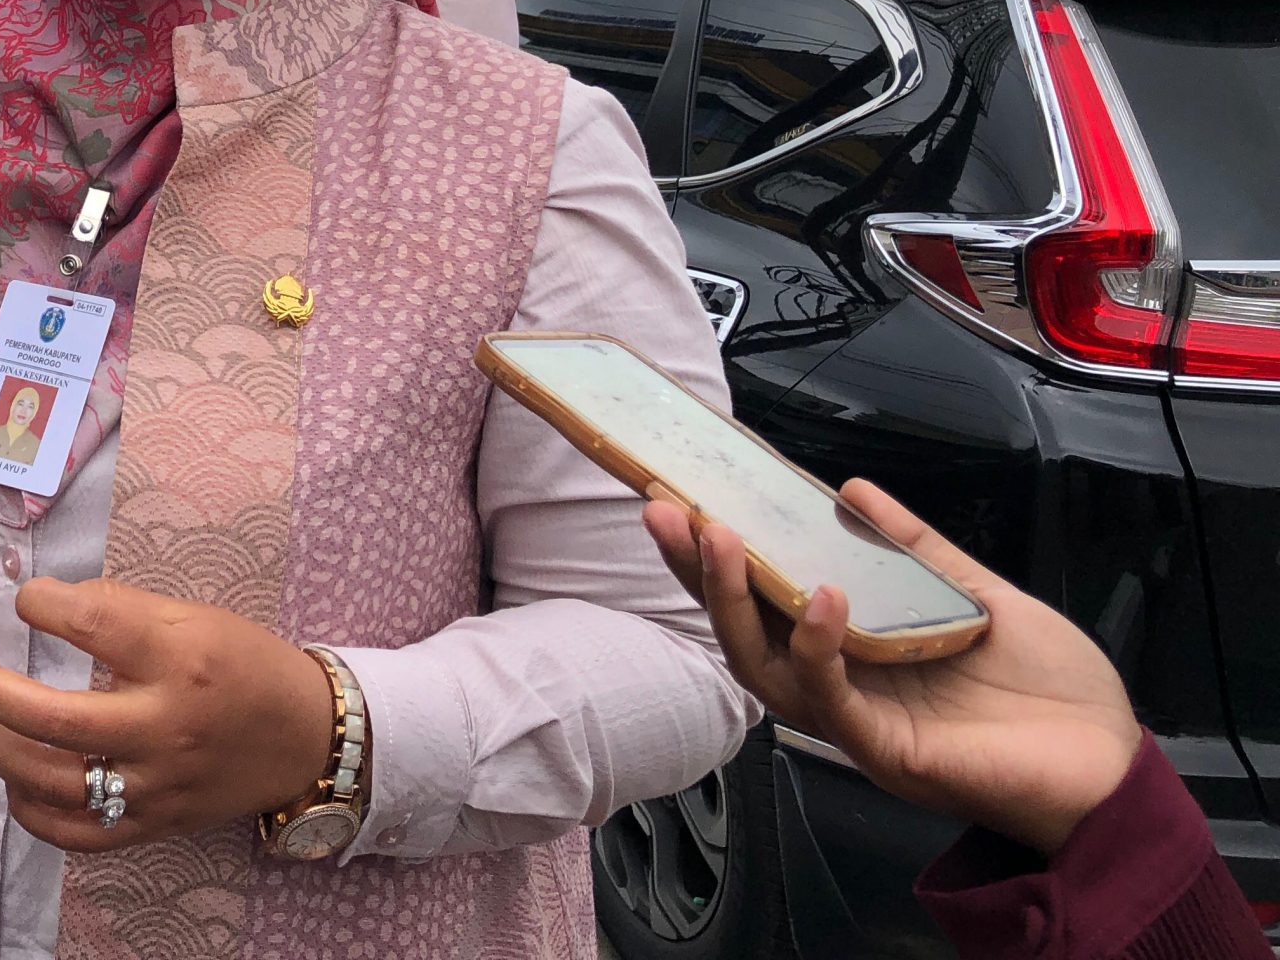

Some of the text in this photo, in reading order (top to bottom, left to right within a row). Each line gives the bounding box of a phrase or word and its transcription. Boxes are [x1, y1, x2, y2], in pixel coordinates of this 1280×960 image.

[4, 338, 82, 364] PEMERINTAH KABUPATEN
[17, 351, 62, 369] PONOROGO
[0, 364, 70, 388] DINAS KESEHATAN
[2, 463, 21, 474] AYU
[20, 467, 28, 475] P
